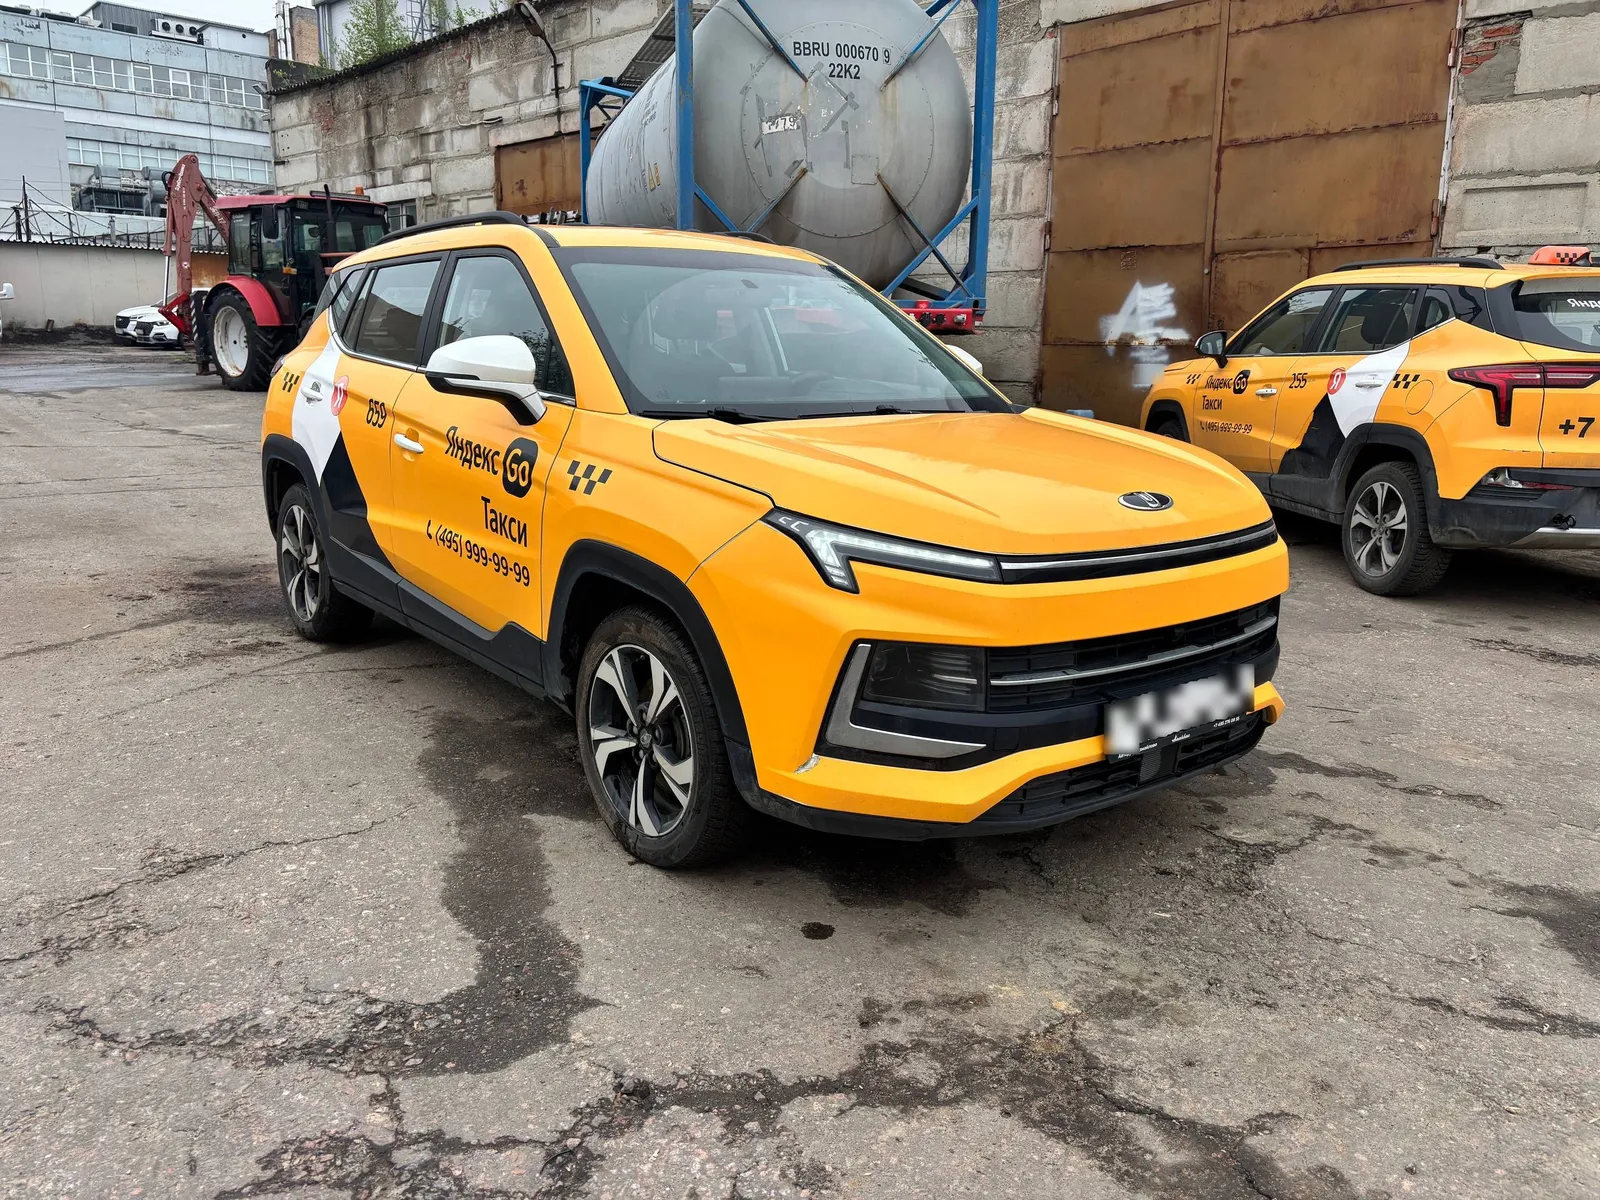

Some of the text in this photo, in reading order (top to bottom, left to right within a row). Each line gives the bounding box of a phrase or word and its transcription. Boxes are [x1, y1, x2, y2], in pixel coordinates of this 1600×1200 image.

[793, 41, 890, 64] BBRU 000670 9
[828, 63, 860, 80] 22K2
[1204, 375, 1233, 390] Яндекс
[1289, 373, 1308, 389] 255
[366, 398, 387, 428] 659
[1202, 395, 1223, 411] Такси
[1205, 420, 1253, 434] (495) 999-99-99
[1558, 416, 1596, 438] +7
[444, 426, 531, 489] Яндекс Go
[481, 496, 528, 547] Такси
[435, 524, 531, 588] (495) 999-99-99
